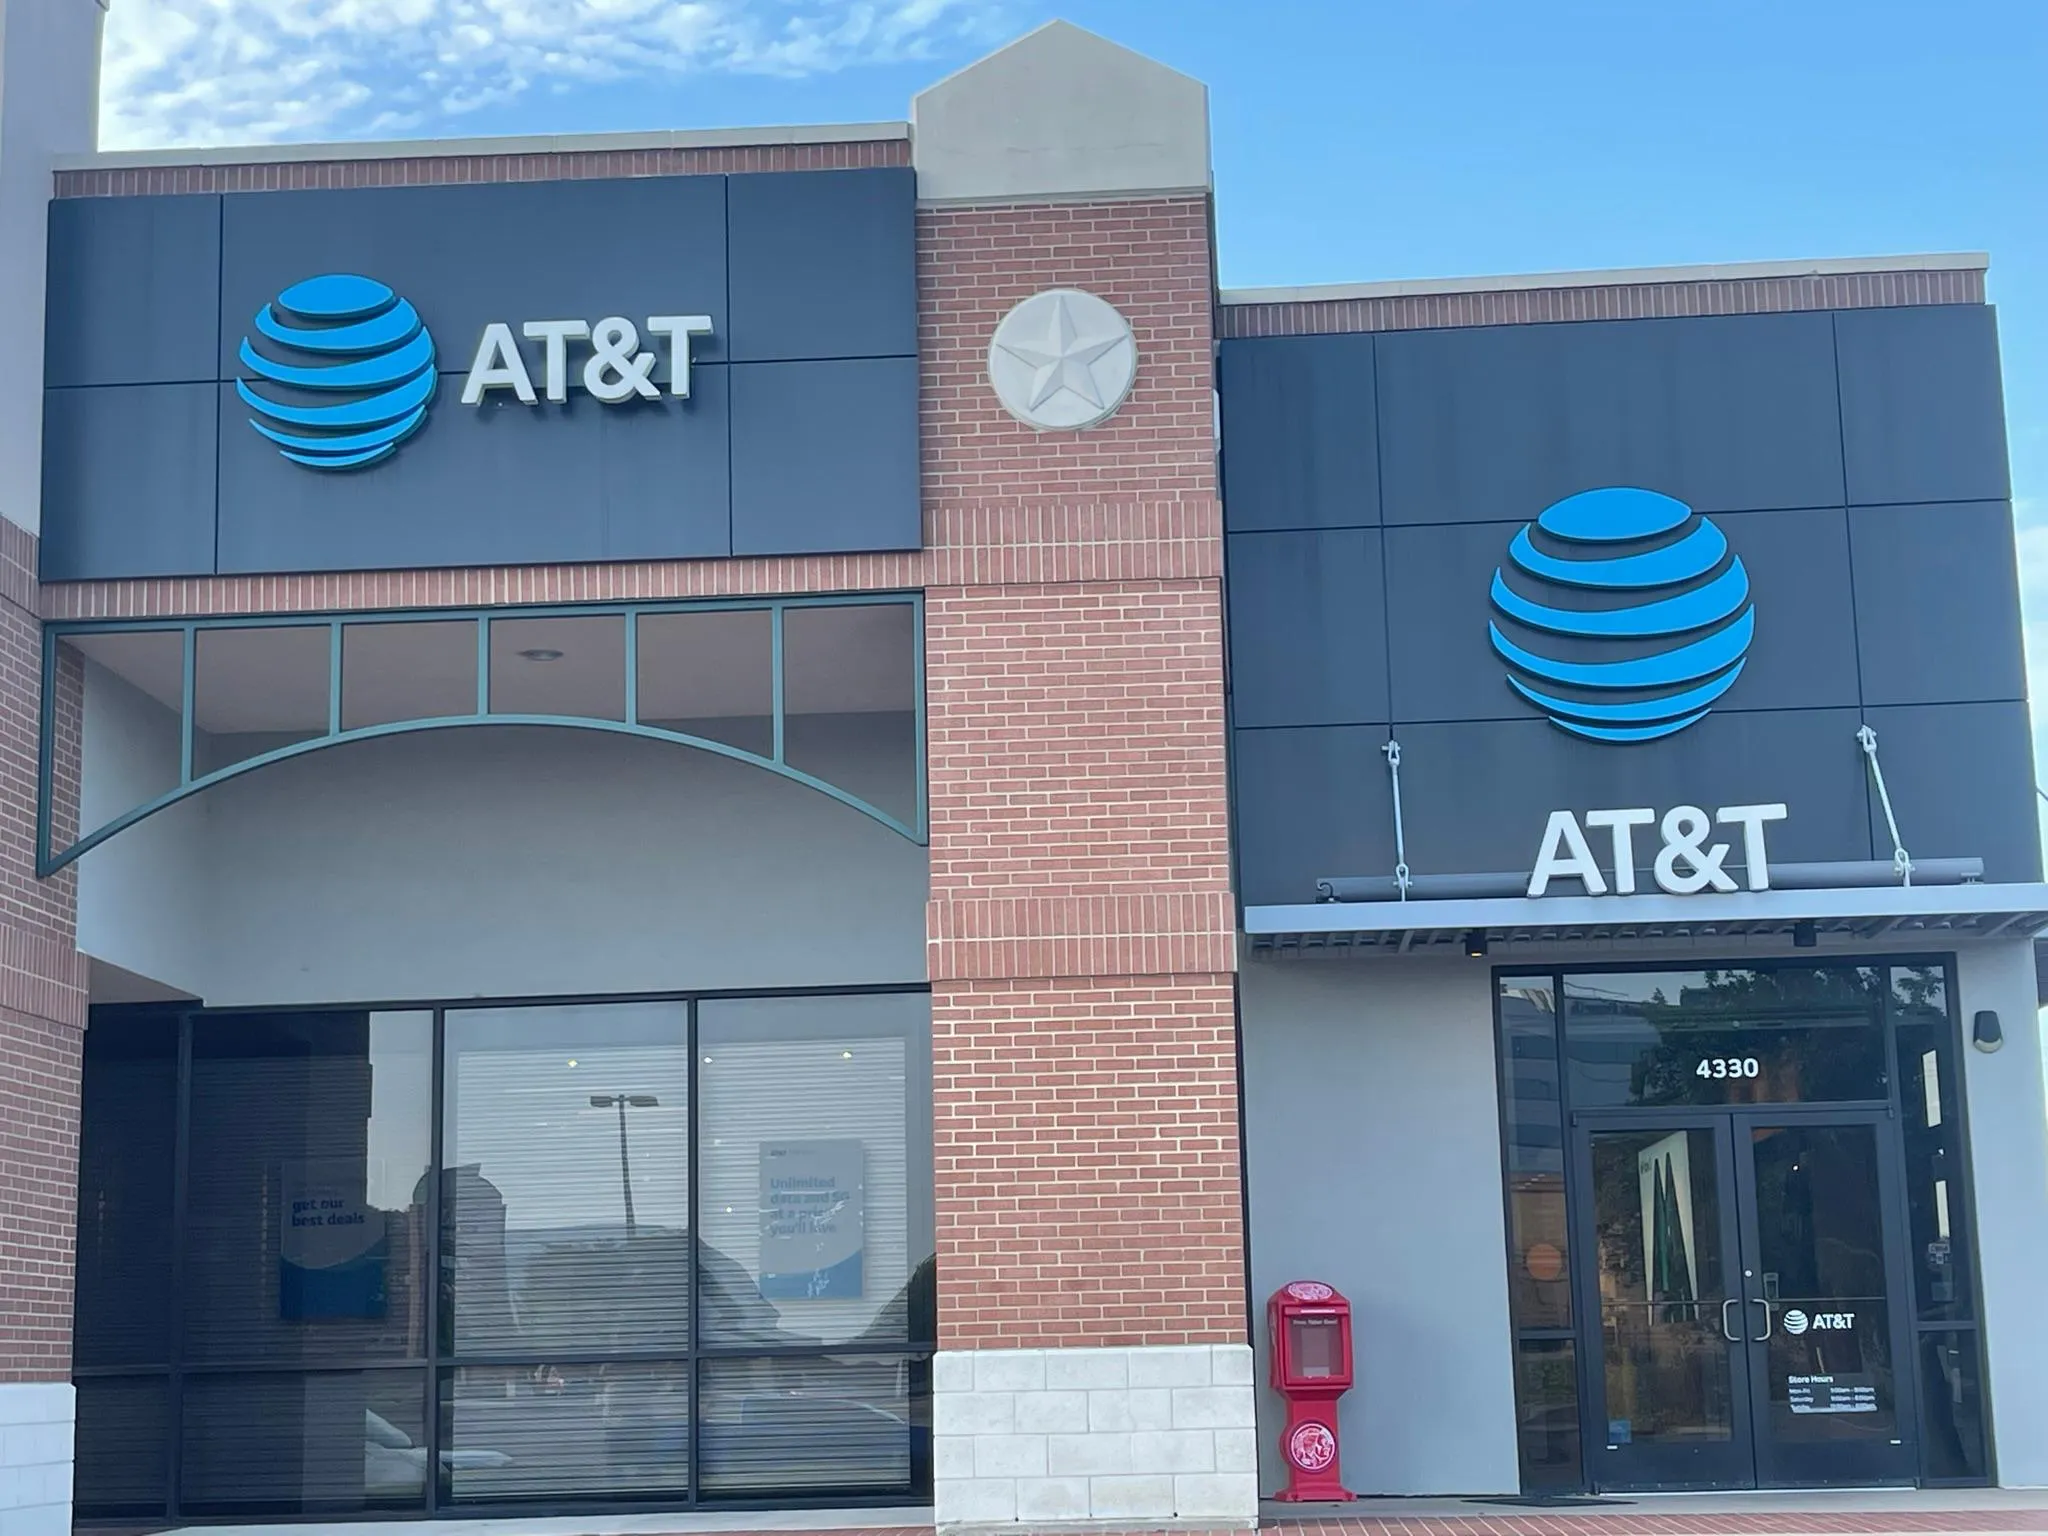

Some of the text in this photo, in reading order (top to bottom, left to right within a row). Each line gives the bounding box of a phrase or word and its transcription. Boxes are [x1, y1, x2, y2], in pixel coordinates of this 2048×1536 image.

[461, 315, 713, 405] AT&T
[1526, 803, 1788, 898] AT&T
[1696, 1057, 1760, 1079] 4330
[770, 1176, 836, 1190] Unlimited
[292, 1200, 345, 1214] get our
[292, 1212, 365, 1227] best deals
[1812, 1313, 1855, 1330] AT&T
[1788, 1375, 1834, 1384] Store Hours
